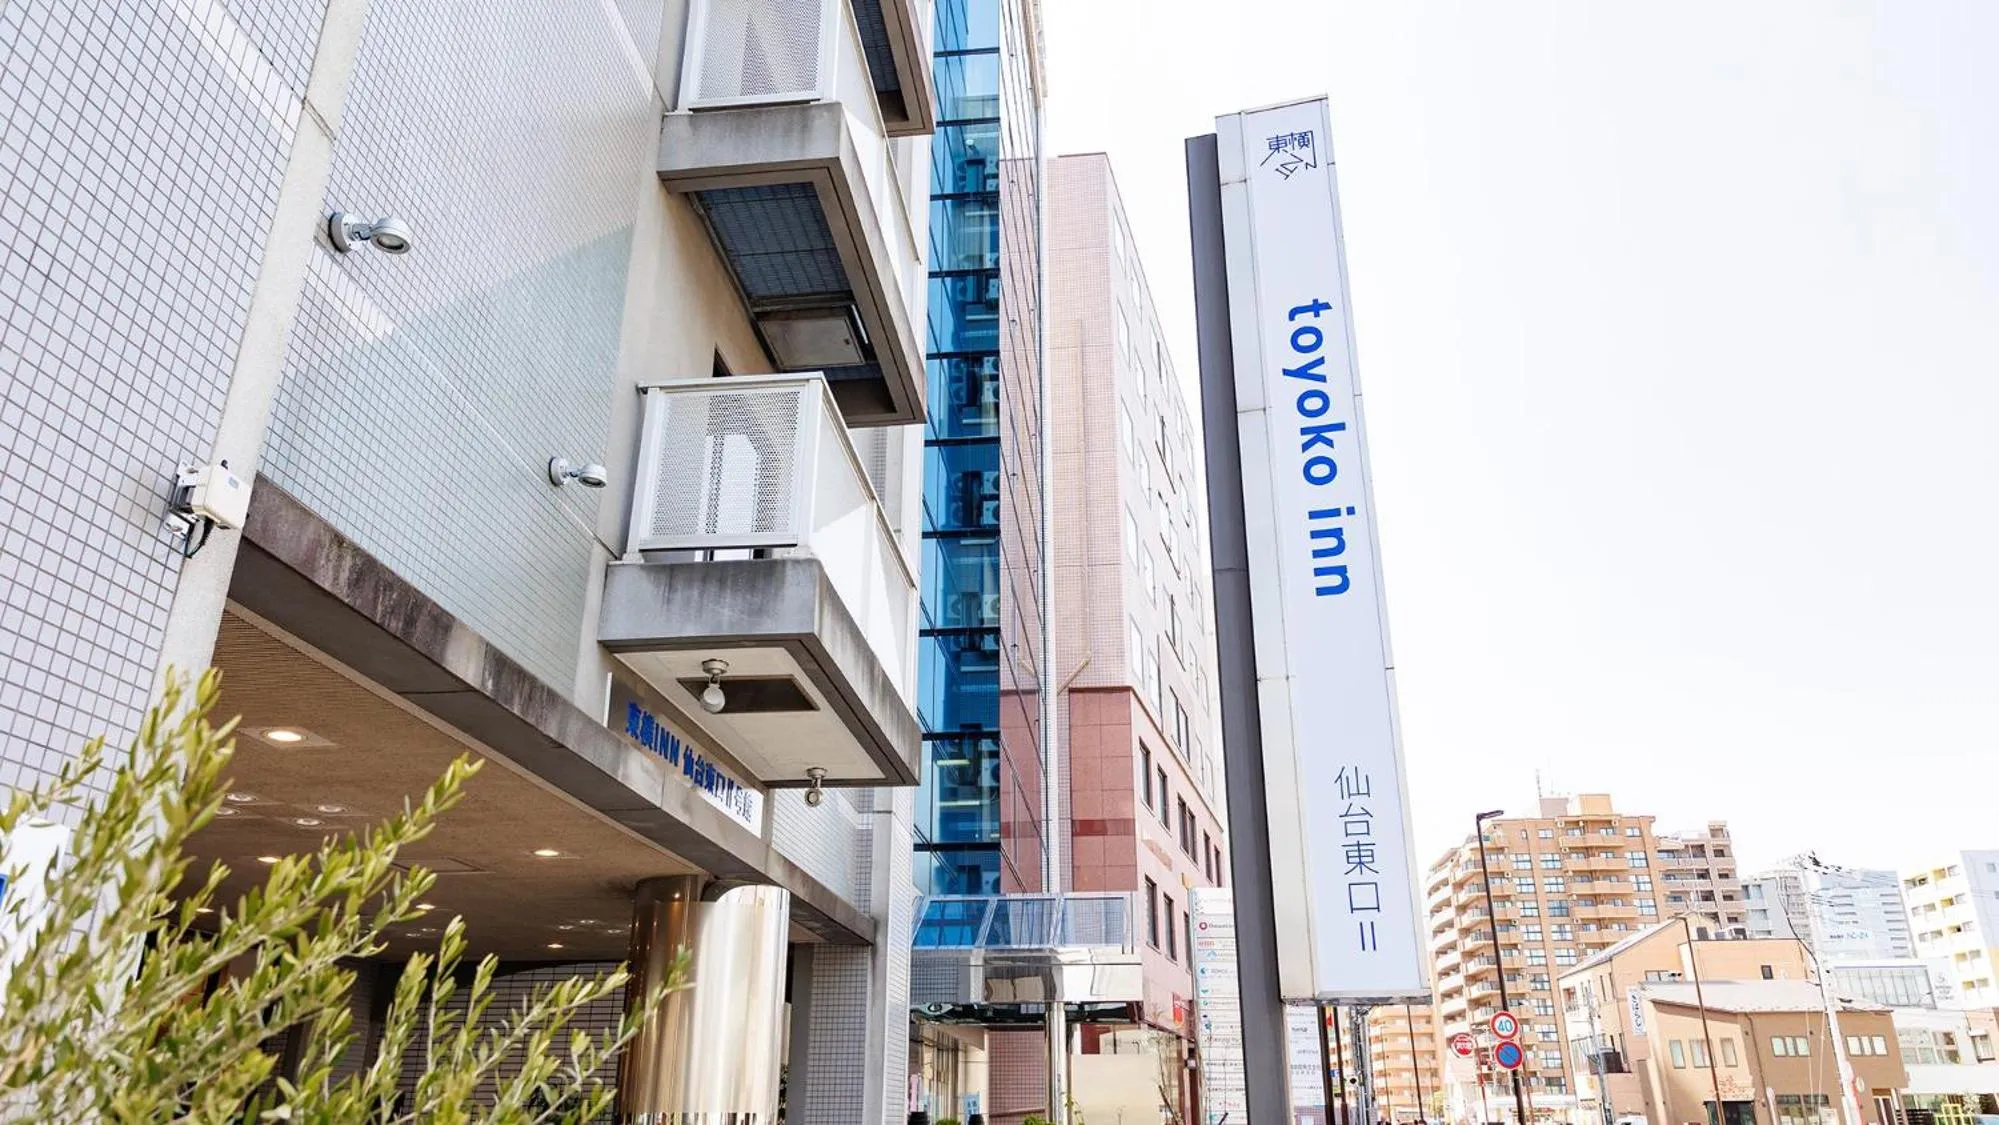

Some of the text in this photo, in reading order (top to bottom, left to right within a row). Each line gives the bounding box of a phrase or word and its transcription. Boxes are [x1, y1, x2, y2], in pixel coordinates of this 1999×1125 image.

[1282, 298, 1356, 596] toyoko inn
[1498, 1020, 1513, 1032] 40
